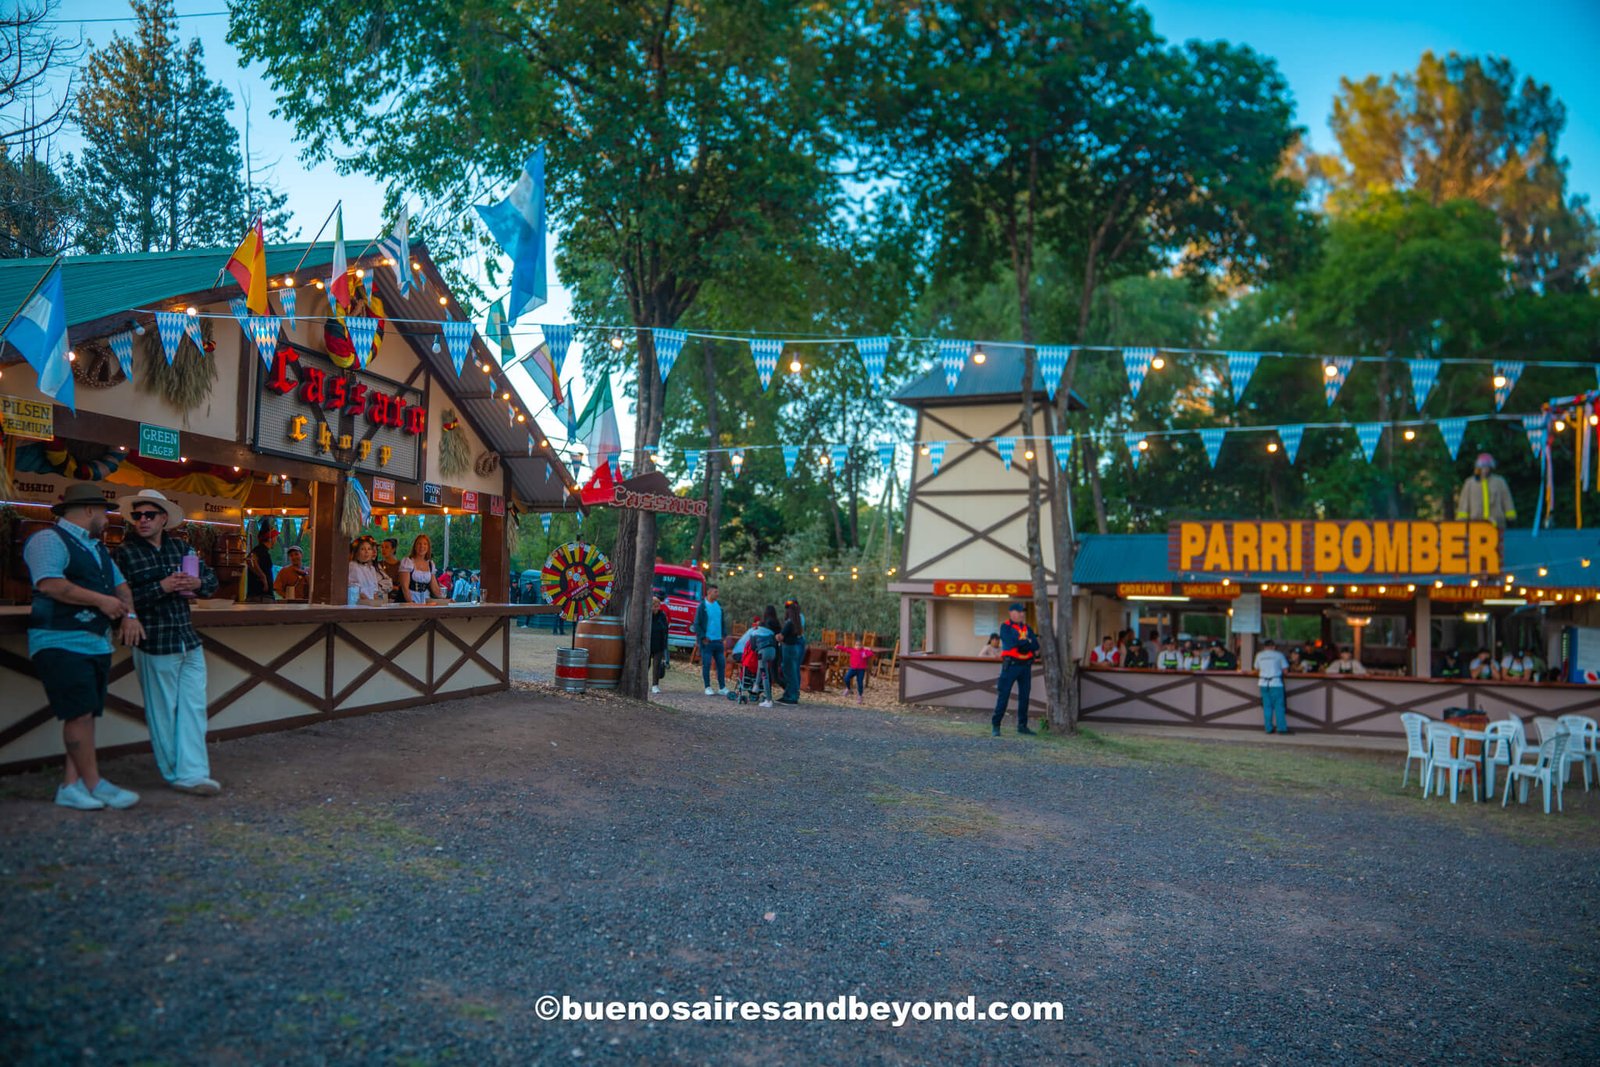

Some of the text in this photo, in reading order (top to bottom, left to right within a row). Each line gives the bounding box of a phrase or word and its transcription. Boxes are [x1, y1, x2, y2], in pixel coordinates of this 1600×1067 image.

[266, 346, 426, 436] Cassaro
[3, 400, 50, 419] PILSEN
[143, 428, 177, 445] GREEN
[147, 444, 175, 457] LAGER
[611, 485, 708, 517] Cassaro
[1180, 521, 1500, 575] PARRI BOMBER
[945, 583, 1018, 594] CAJAS
